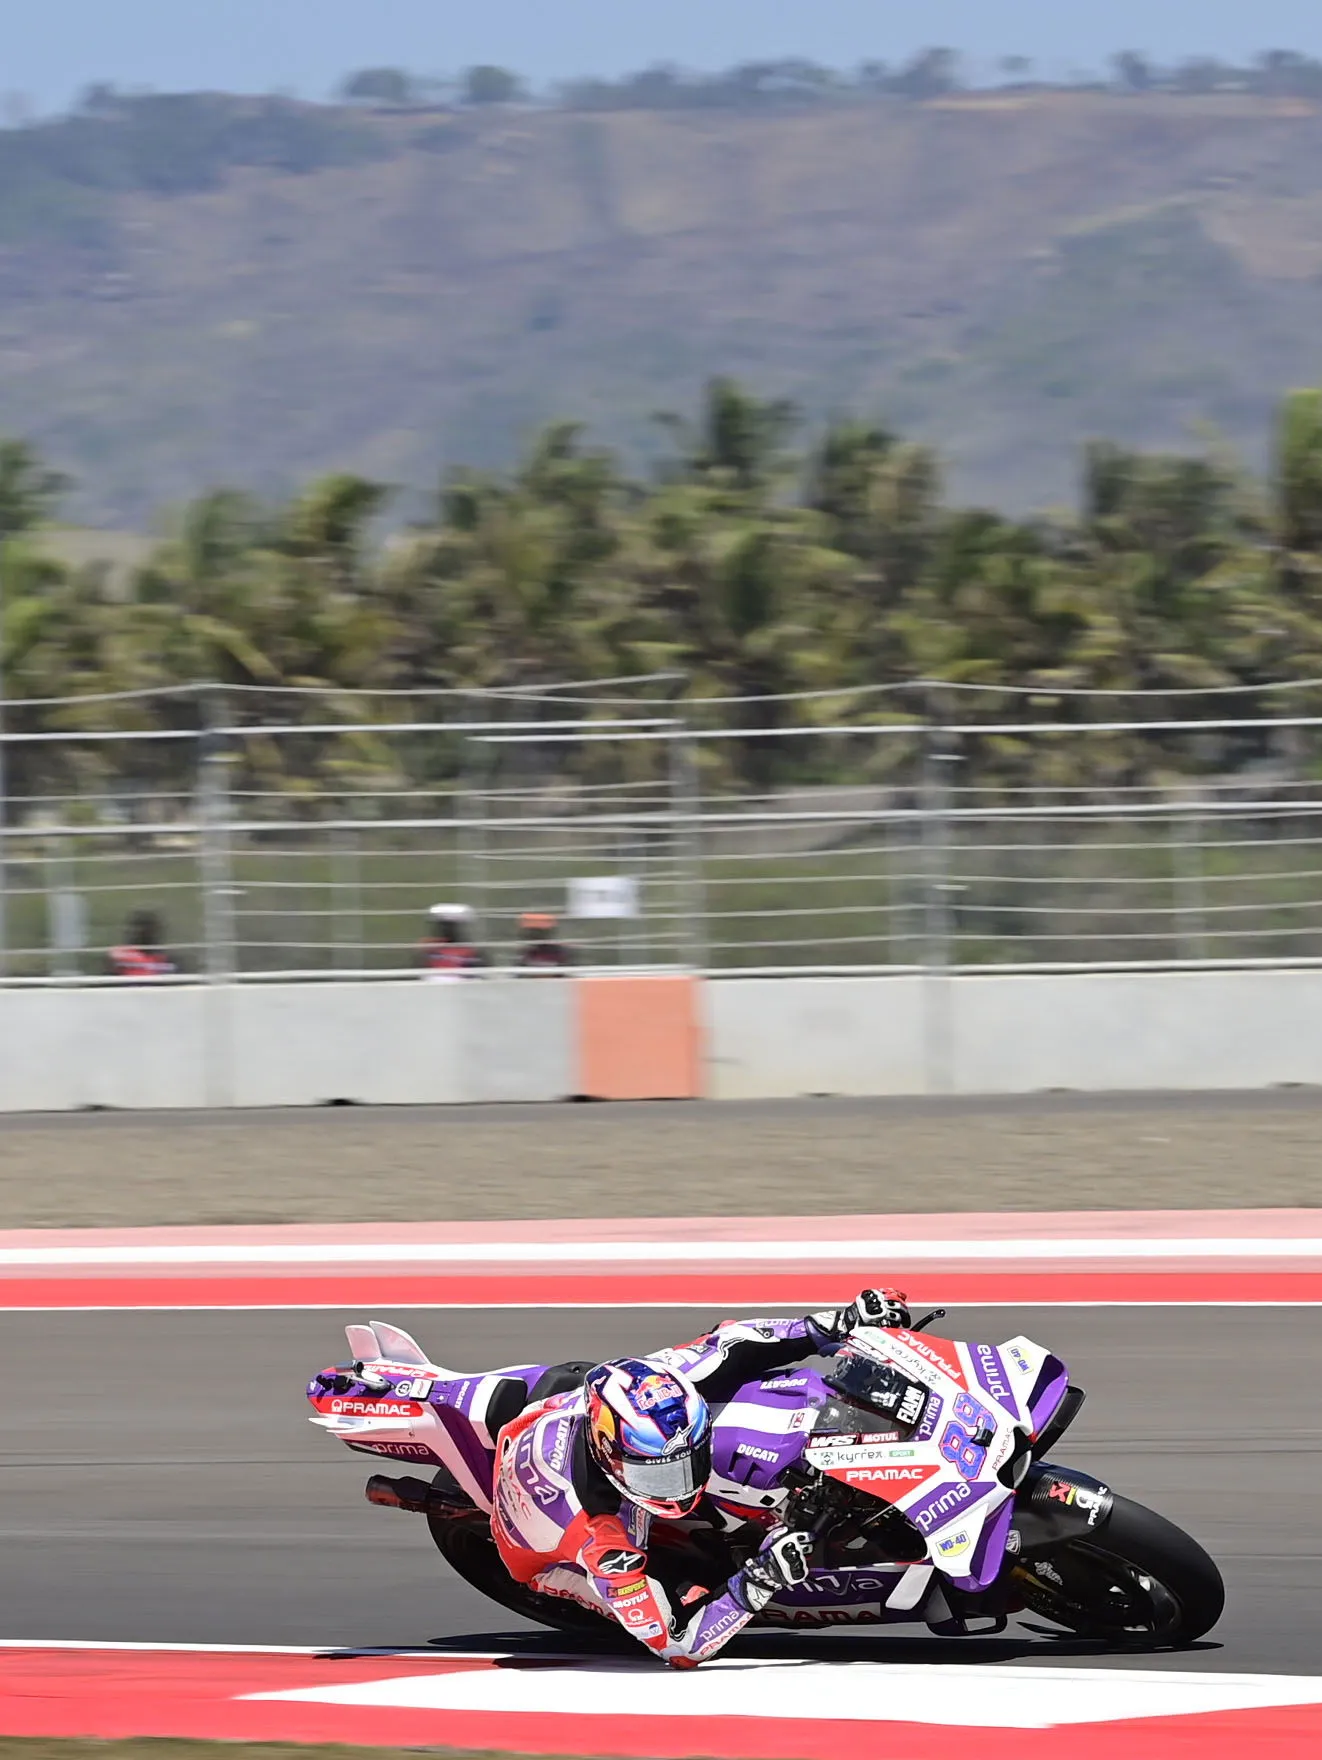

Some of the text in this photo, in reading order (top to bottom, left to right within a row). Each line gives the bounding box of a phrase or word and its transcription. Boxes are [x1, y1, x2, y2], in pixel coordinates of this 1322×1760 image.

[898, 1331, 961, 1379] PRAMAC
[977, 1344, 1010, 1400] prima
[760, 1378, 808, 1389] DUCATI
[342, 1403, 411, 1416] PRAMAC
[919, 1396, 941, 1436] prima
[550, 1418, 570, 1471] DUCATI
[861, 1432, 899, 1444] MOTUL
[938, 1392, 998, 1482] 89
[371, 1443, 430, 1456] prima
[736, 1443, 780, 1463] DUCATI
[837, 1449, 883, 1462] kyrrex
[846, 1468, 923, 1481] PRAMAC
[915, 1482, 971, 1531] prima
[1087, 1486, 1108, 1526] PRAC
[940, 1533, 967, 1552] WD-40
[613, 1591, 649, 1609] MOTUL
[700, 1610, 740, 1641] prima
